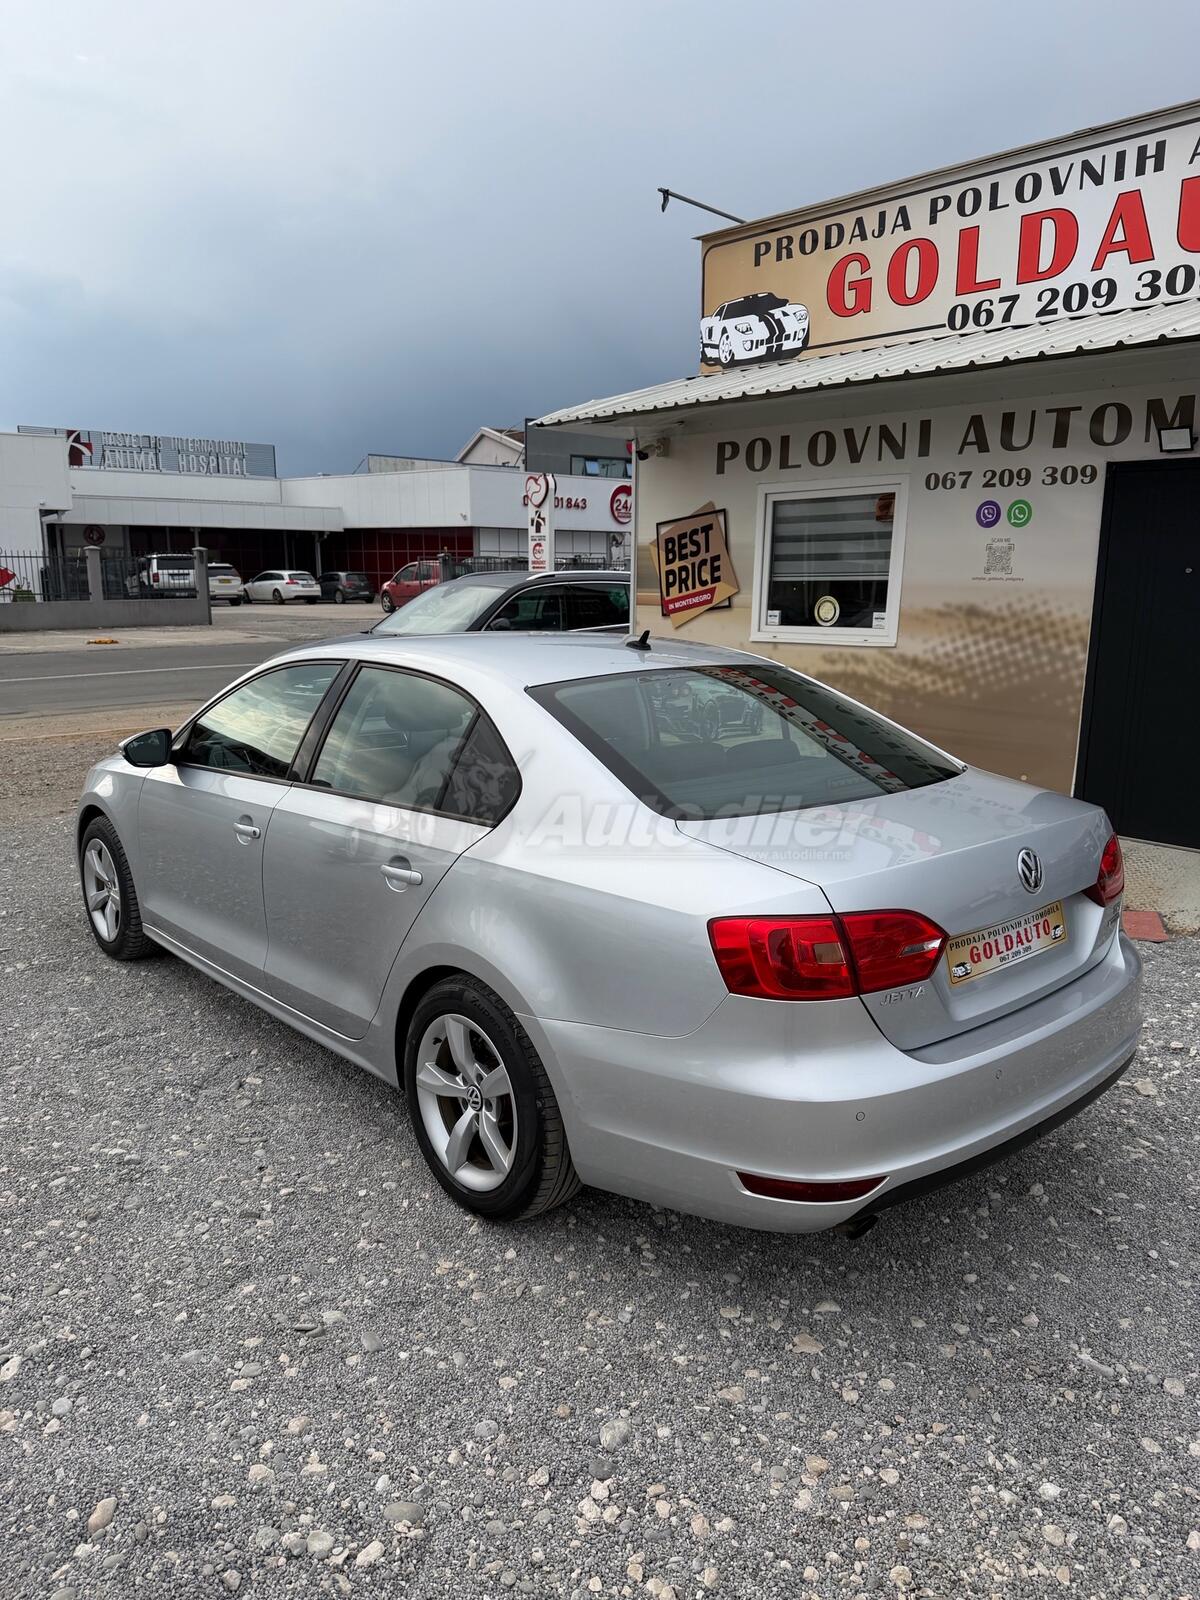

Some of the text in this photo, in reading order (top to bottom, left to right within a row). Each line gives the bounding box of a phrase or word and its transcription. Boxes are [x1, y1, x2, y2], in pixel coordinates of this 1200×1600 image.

[754, 140, 1167, 268] PRODAJA POLOVNIH
[947, 264, 1200, 331] 067 209 30
[171, 437, 248, 455] INTERNATIONAL
[715, 395, 1196, 475] POLOVNI AUTOM
[104, 450, 248, 477] ANIMAL HOSPITAL
[925, 464, 1098, 491] 067 209 309
[615, 499, 632, 511] 24/
[664, 523, 714, 565] BEST
[665, 554, 721, 597] PRICE
[675, 593, 712, 608] MONTENEGRO
[949, 904, 1060, 951] PRODAJA POLOVNIH AUTOMOBILA
[970, 918, 1050, 965] GOLDAUTO
[999, 945, 1032, 963] 067 209 309
[880, 986, 925, 1006] JETTA
